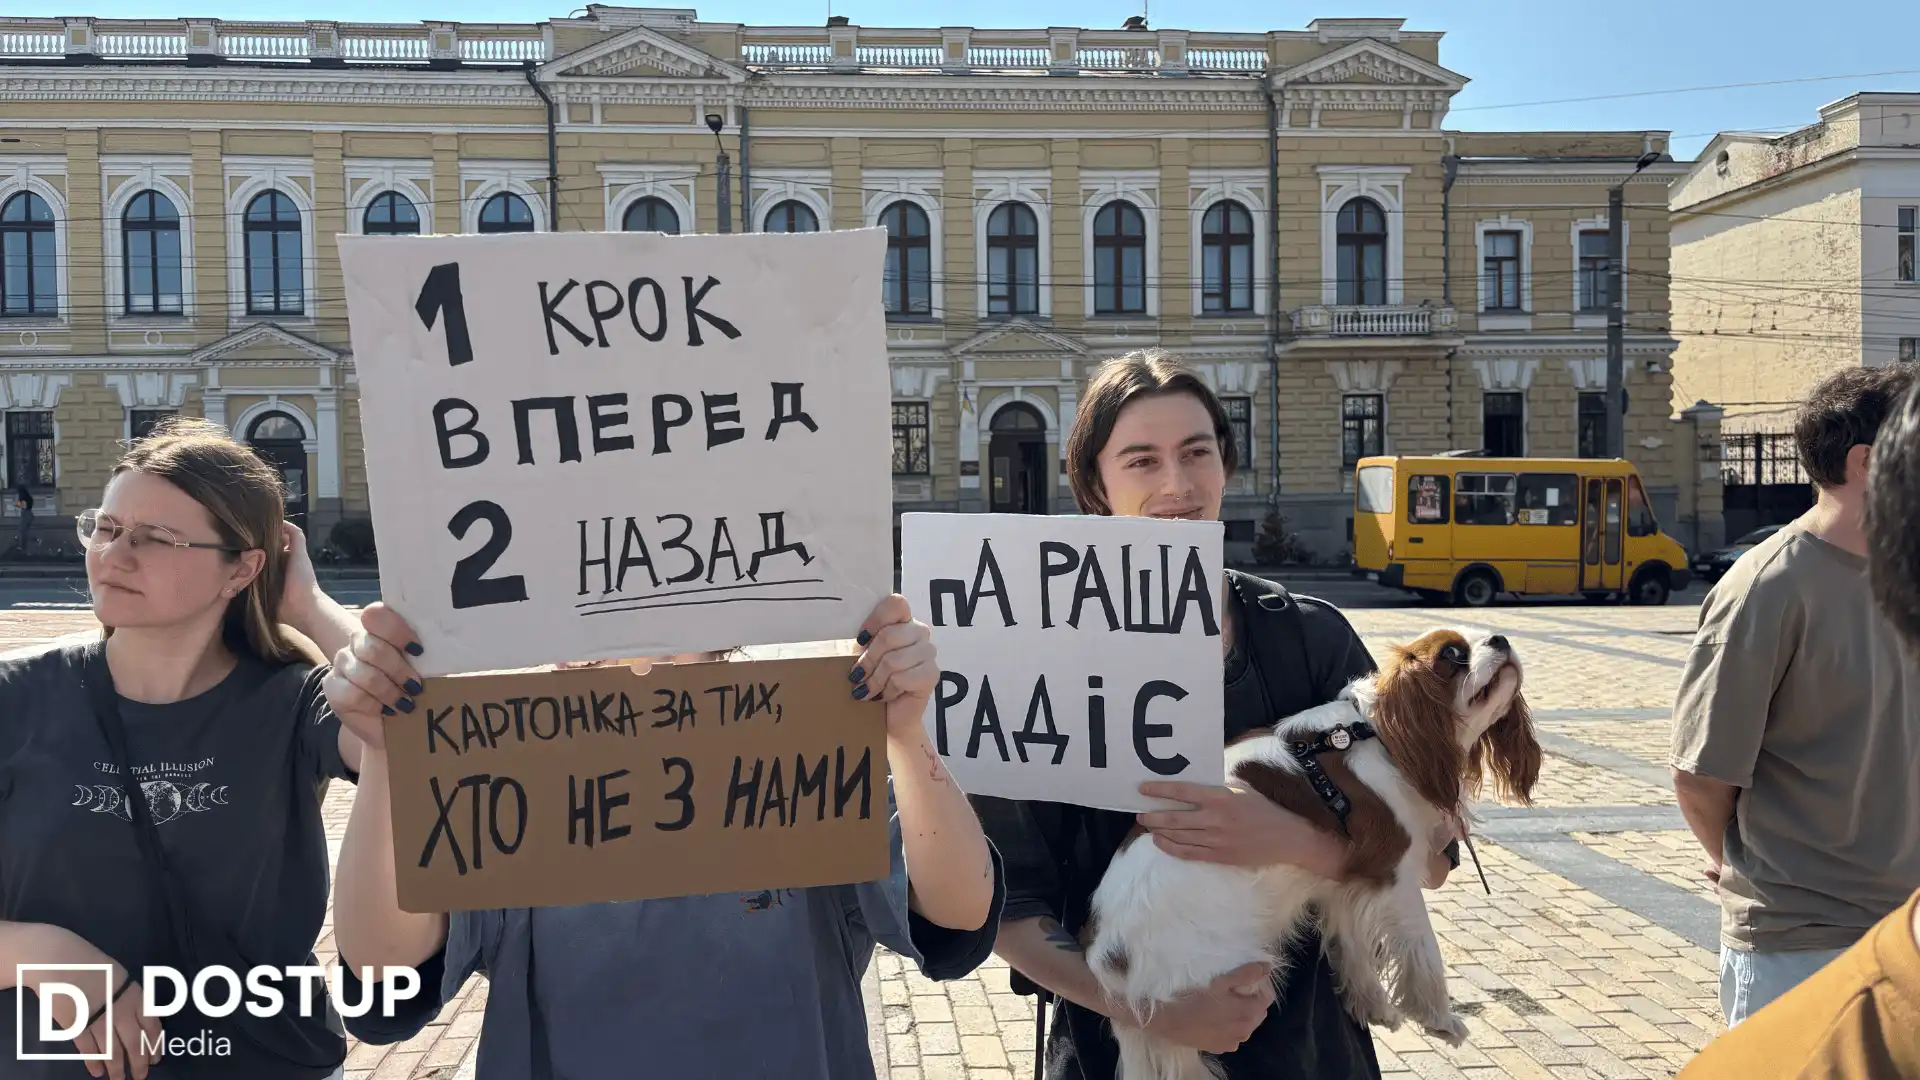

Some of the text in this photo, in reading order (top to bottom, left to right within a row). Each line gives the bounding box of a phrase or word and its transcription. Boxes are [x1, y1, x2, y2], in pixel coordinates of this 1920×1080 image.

[414, 261, 742, 367] 1 КРОК
[432, 381, 819, 470] ВПЕРЕД
[447, 499, 816, 610] 2 НАЗАД
[1039, 540, 1221, 637] РАША
[93, 761, 157, 776] CELTIAL
[160, 757, 215, 772] ILLUSION
[426, 682, 784, 756] КАРТОНКА ЗА ТИХ,
[418, 773, 528, 876] ХТО
[567, 768, 632, 849] НЕ
[723, 745, 872, 830] НАМИ
